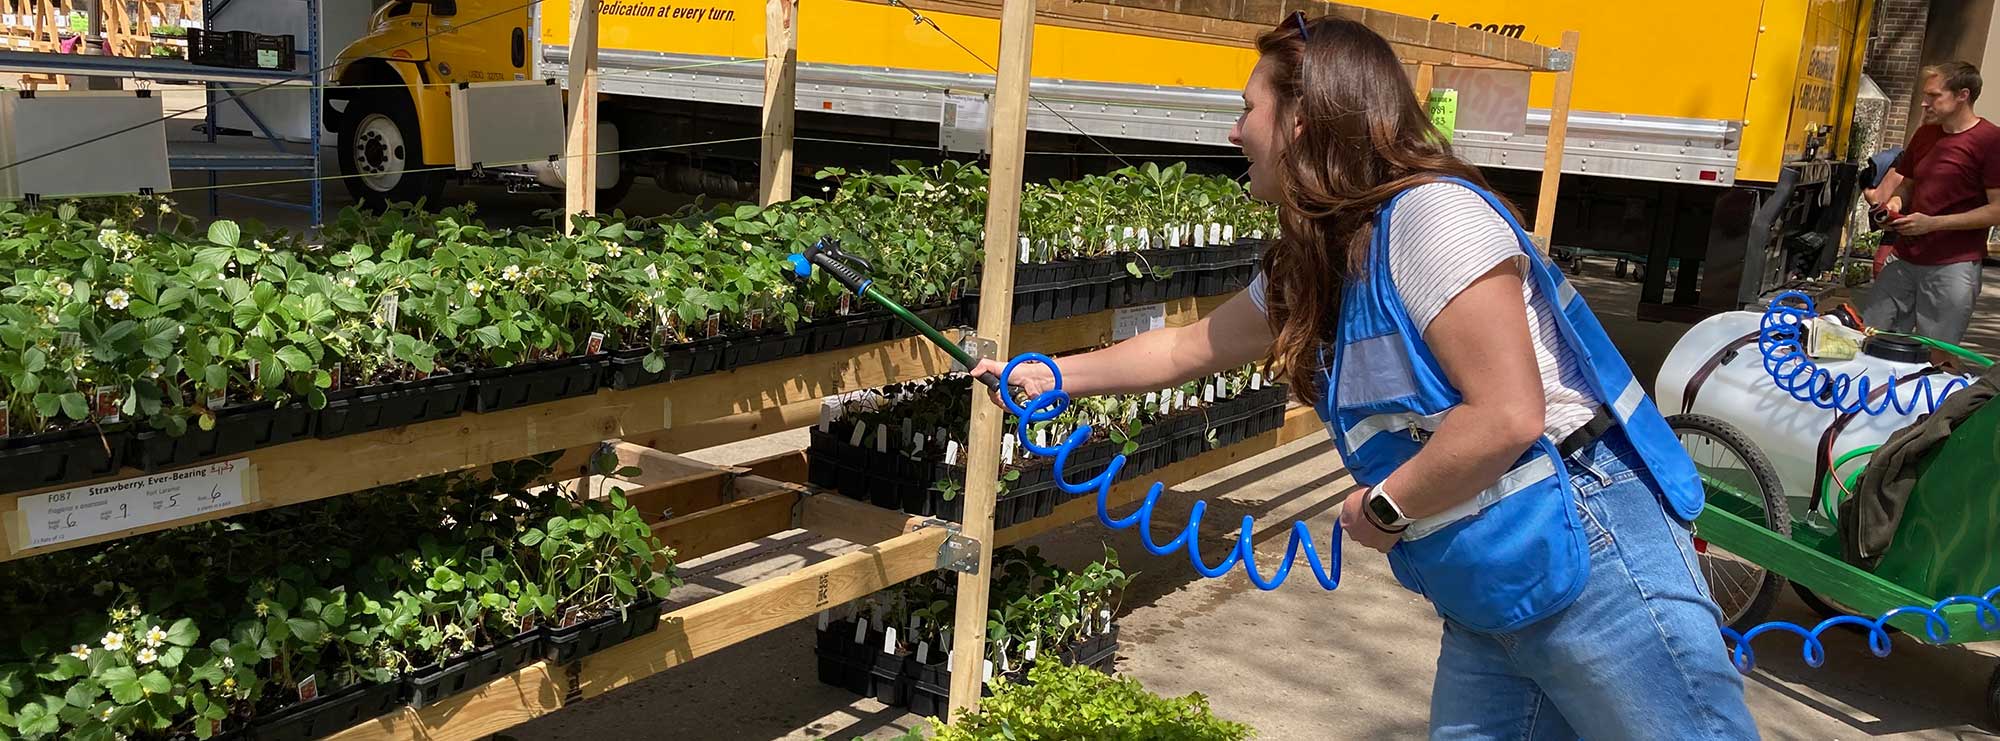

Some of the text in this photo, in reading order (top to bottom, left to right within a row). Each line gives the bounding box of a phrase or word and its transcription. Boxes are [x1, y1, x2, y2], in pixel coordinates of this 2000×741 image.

[658, 6, 670, 18] at
[674, 7, 706, 23] every
[708, 9, 736, 22] turn.
[48, 468, 207, 503] F087 Strawberry, Ever-Bearing
[210, 483, 221, 503] 6
[169, 493, 181, 508] 5
[120, 503, 127, 519] 9
[66, 512, 77, 528] 6
